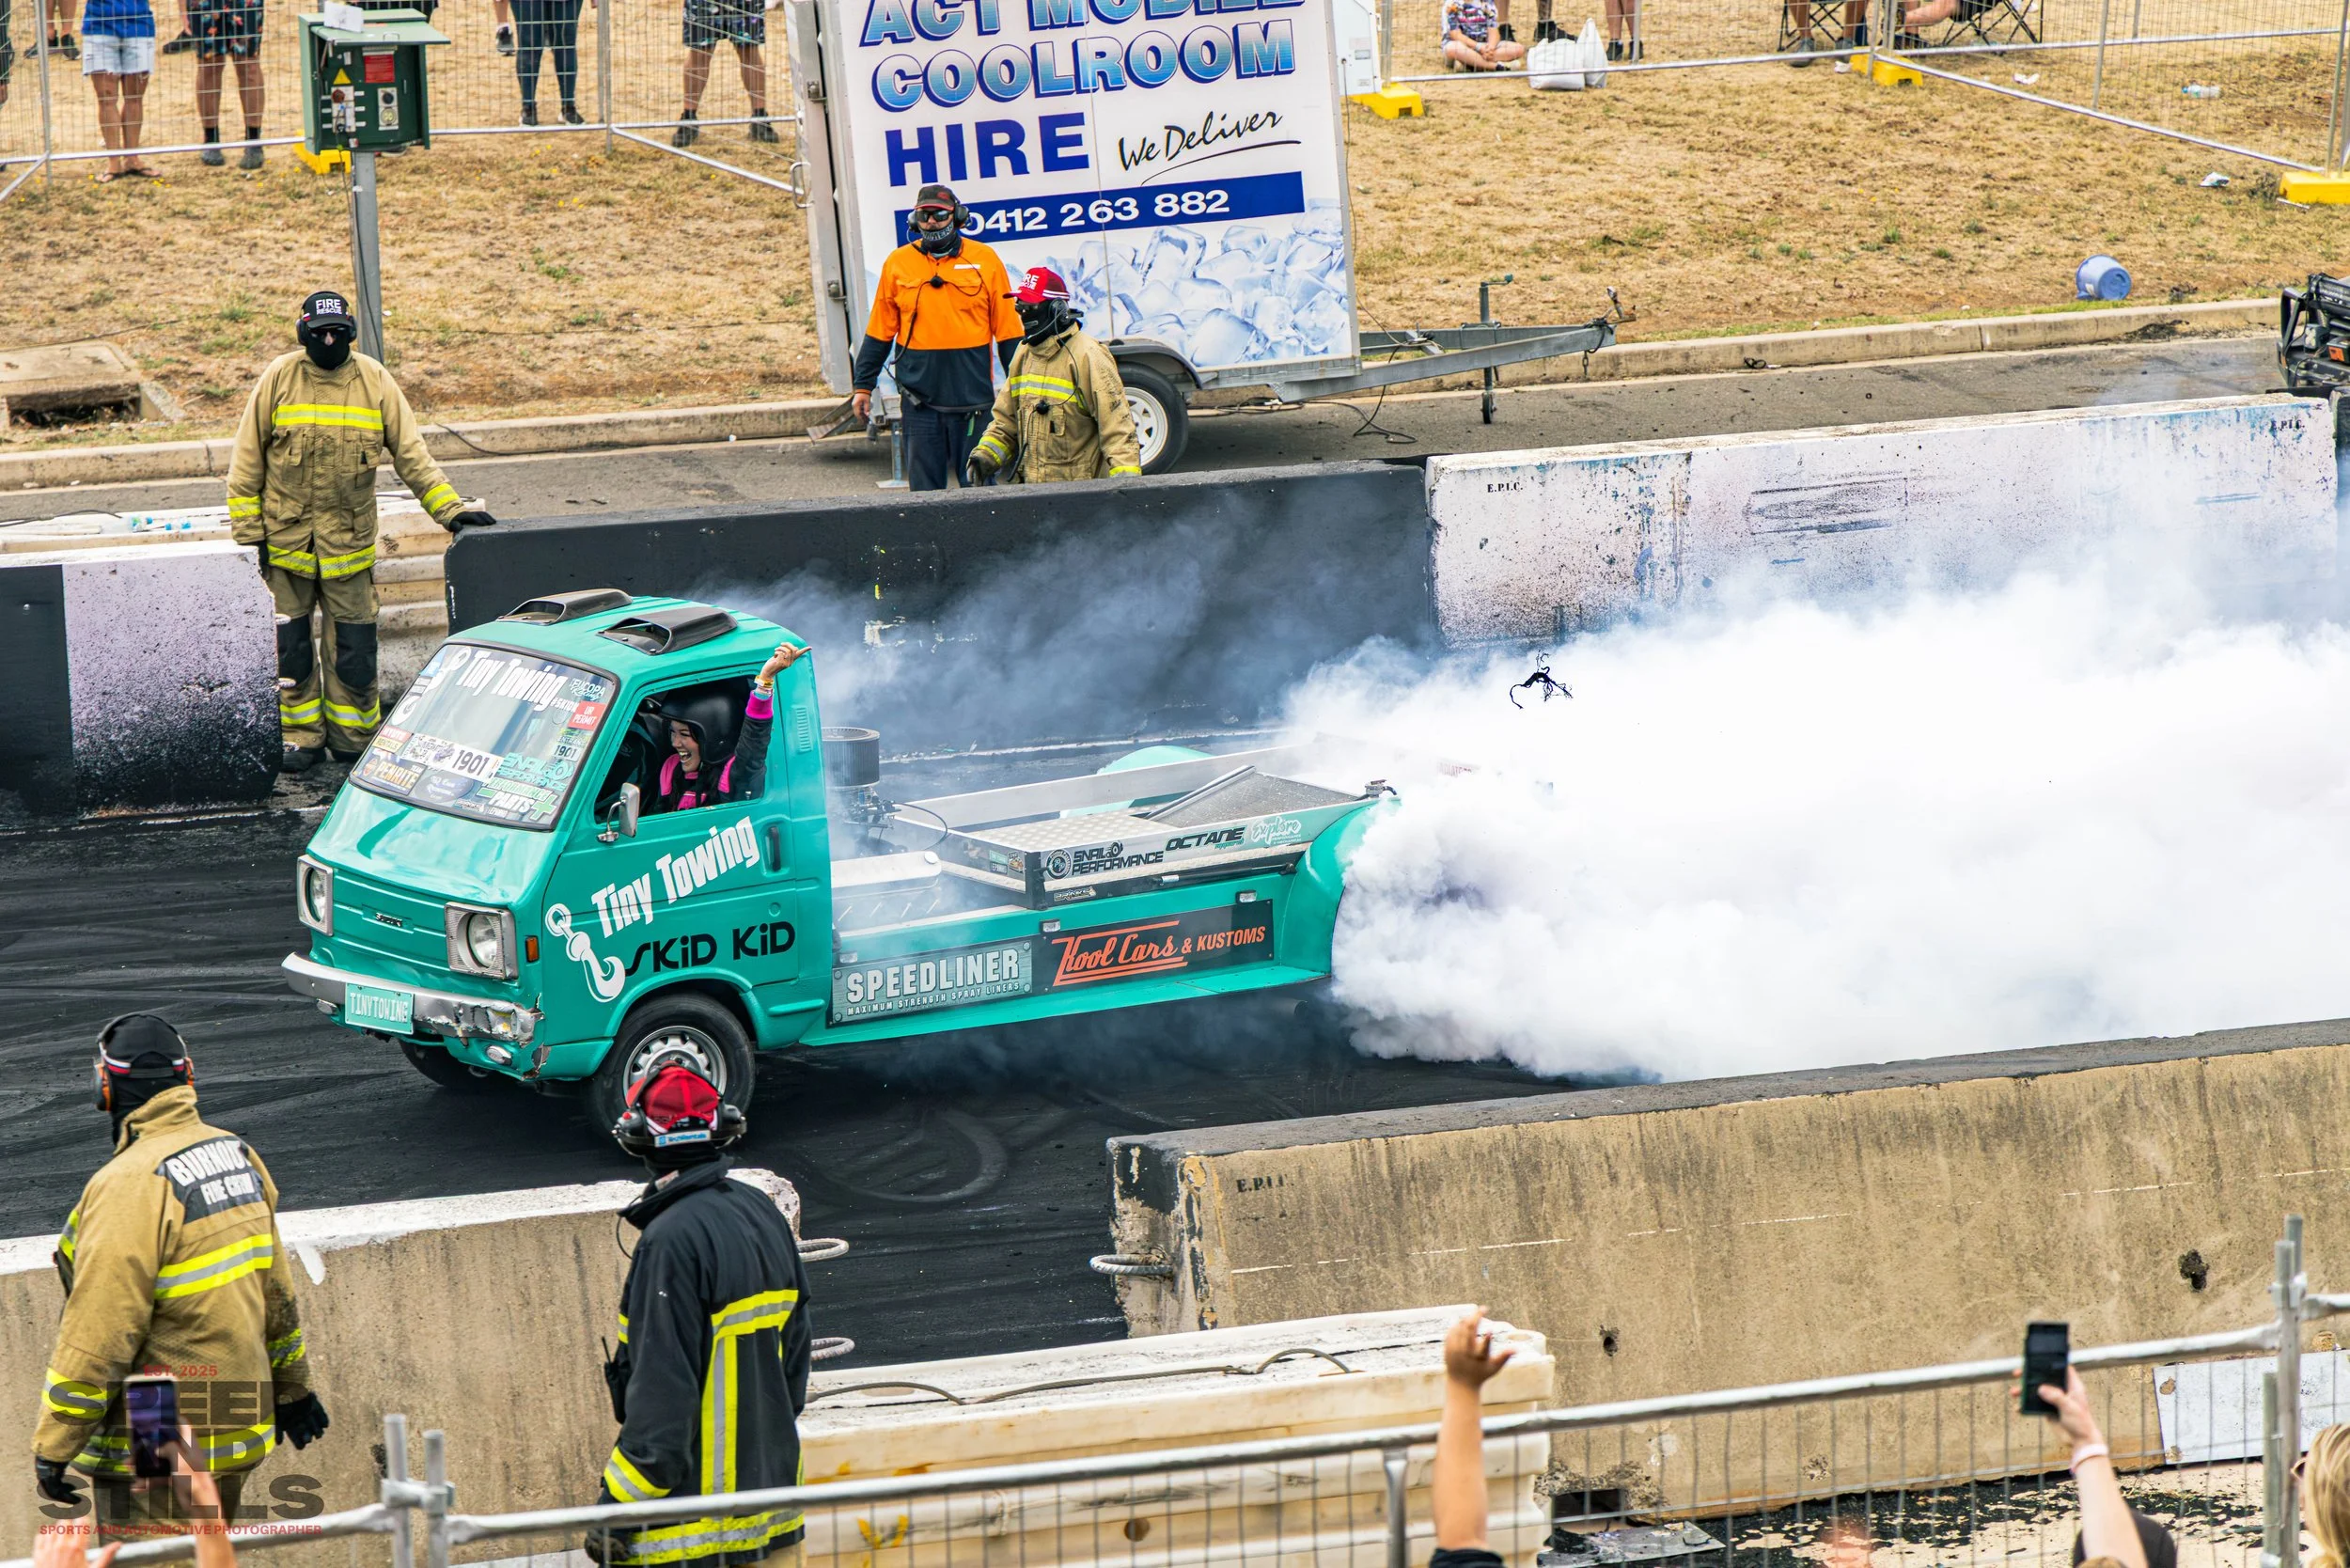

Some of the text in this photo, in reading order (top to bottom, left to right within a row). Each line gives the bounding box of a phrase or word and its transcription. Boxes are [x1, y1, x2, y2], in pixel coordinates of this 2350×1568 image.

[871, 19, 1295, 112] COOLROOM
[885, 112, 1089, 186] HIRE
[1119, 111, 1283, 171] We Deliver
[1059, 197, 1139, 227] 263
[1154, 190, 1230, 217] 882
[316, 299, 341, 310] FIRE
[1487, 481, 1524, 493] E.P.I.C.
[455, 650, 569, 712] Tiny Towing
[452, 750, 490, 776] 1901
[555, 745, 578, 759] 1901
[374, 761, 420, 789] PENRITE
[489, 791, 536, 813] PARTS
[1166, 826, 1246, 851] OCTANE
[1251, 816, 1302, 844] Explore
[1072, 851, 1164, 875] PERFORMANCE
[1073, 847, 1106, 863] SNAIL
[591, 816, 760, 938] Tiny Towing
[1053, 925, 1266, 984] Kool Cars & KUSTOMS
[847, 949, 1019, 1003] SPEEDLINER
[351, 993, 408, 1023] TINYTOWING
[847, 982, 1019, 1016] MAXIMUM STRENGTH SPRAY LINERS
